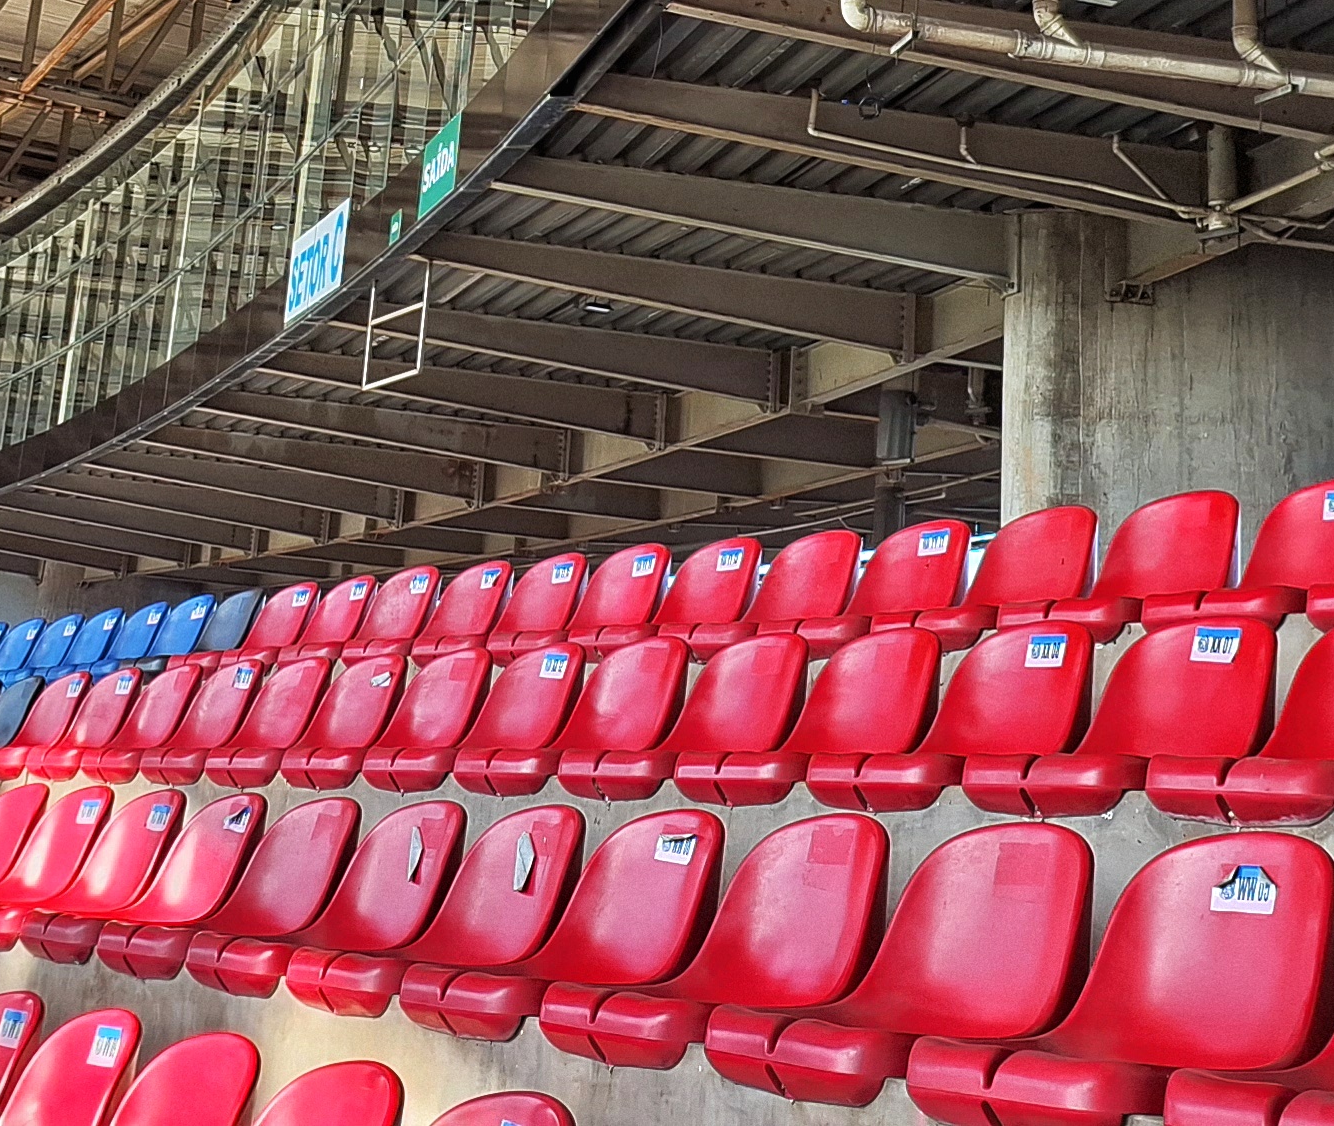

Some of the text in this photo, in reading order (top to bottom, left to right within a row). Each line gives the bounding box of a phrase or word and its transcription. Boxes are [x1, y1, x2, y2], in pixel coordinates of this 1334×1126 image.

[422, 141, 455, 193] SAÍDA
[288, 210, 344, 313] SETOR C
[1237, 876, 1258, 901] WW
